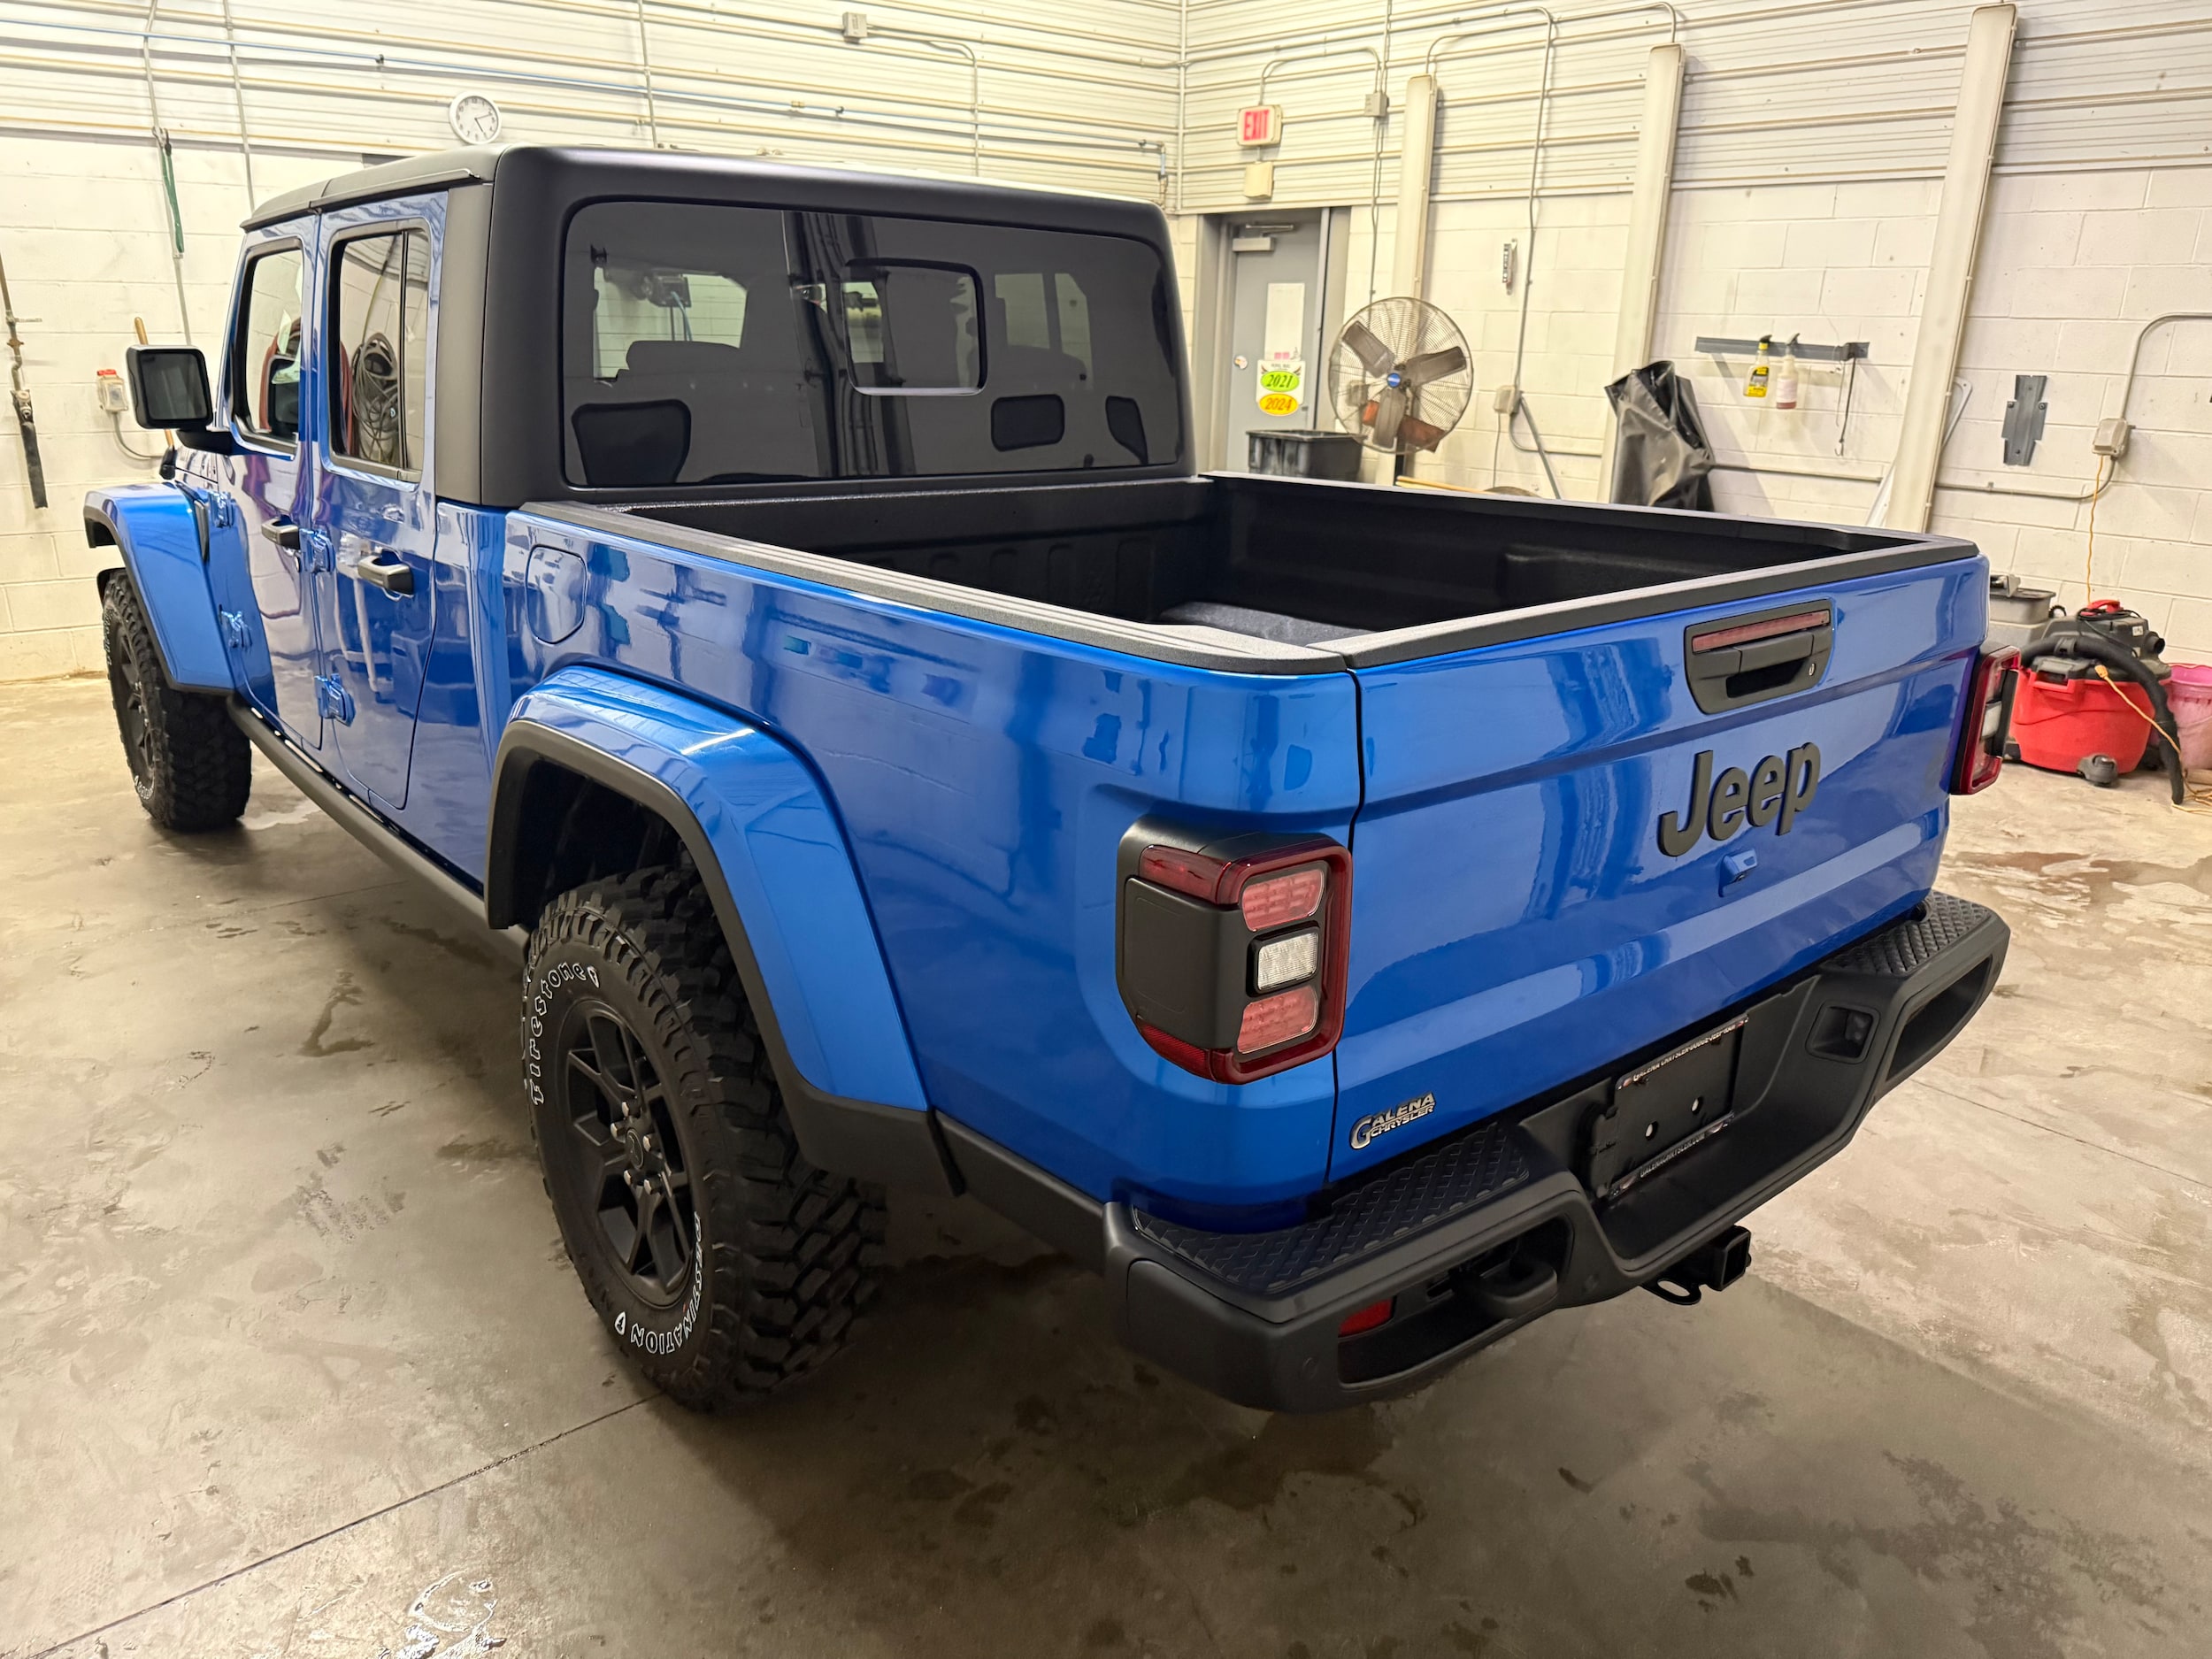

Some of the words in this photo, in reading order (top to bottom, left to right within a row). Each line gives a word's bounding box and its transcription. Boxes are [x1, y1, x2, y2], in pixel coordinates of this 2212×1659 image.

[1243, 109, 1270, 141] EXIT
[1266, 374, 1294, 388] 2021
[1264, 397, 1293, 411] 2024
[1656, 741, 1821, 857] Jeep
[1350, 1092, 1435, 1149] GALENA
[1371, 1105, 1433, 1137] CHRYSLER
[630, 1210, 703, 1355] DESTINATION
